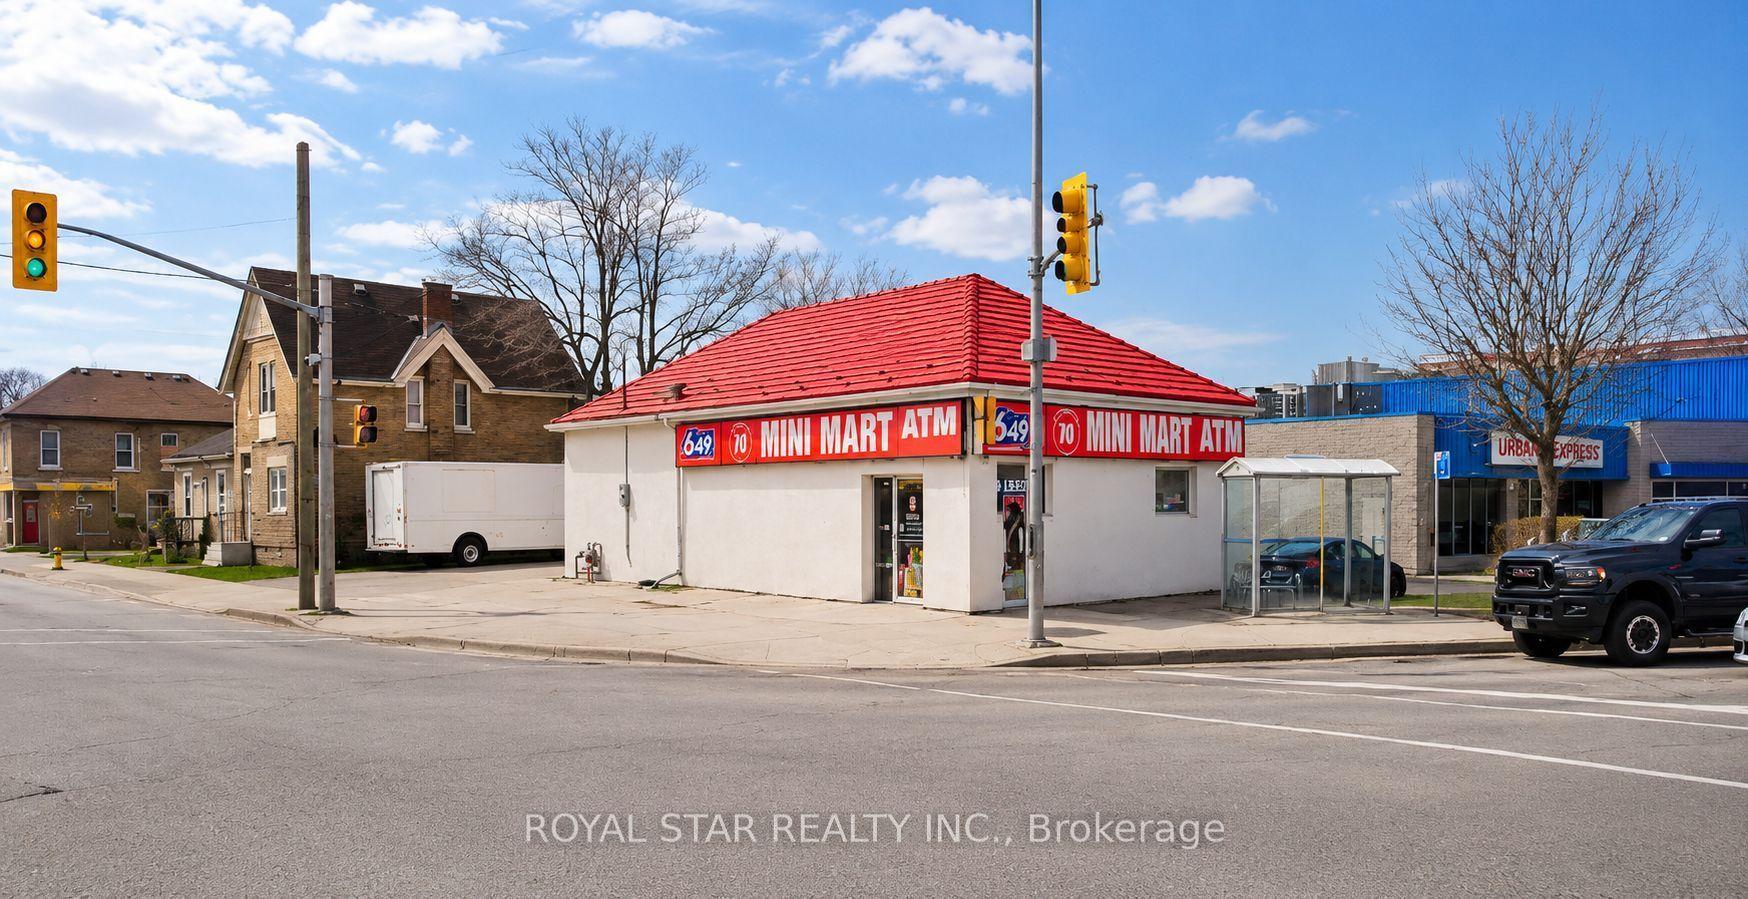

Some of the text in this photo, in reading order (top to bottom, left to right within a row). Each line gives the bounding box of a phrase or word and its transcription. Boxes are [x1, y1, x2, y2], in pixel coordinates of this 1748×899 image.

[761, 411, 893, 458] MINI MART
[901, 406, 957, 439] ATM
[995, 411, 1029, 442] 649
[1058, 423, 1075, 445] 70
[1086, 410, 1193, 454] MINI MART
[1200, 418, 1243, 453] ATM
[683, 431, 712, 456] 649
[733, 433, 747, 455] 70
